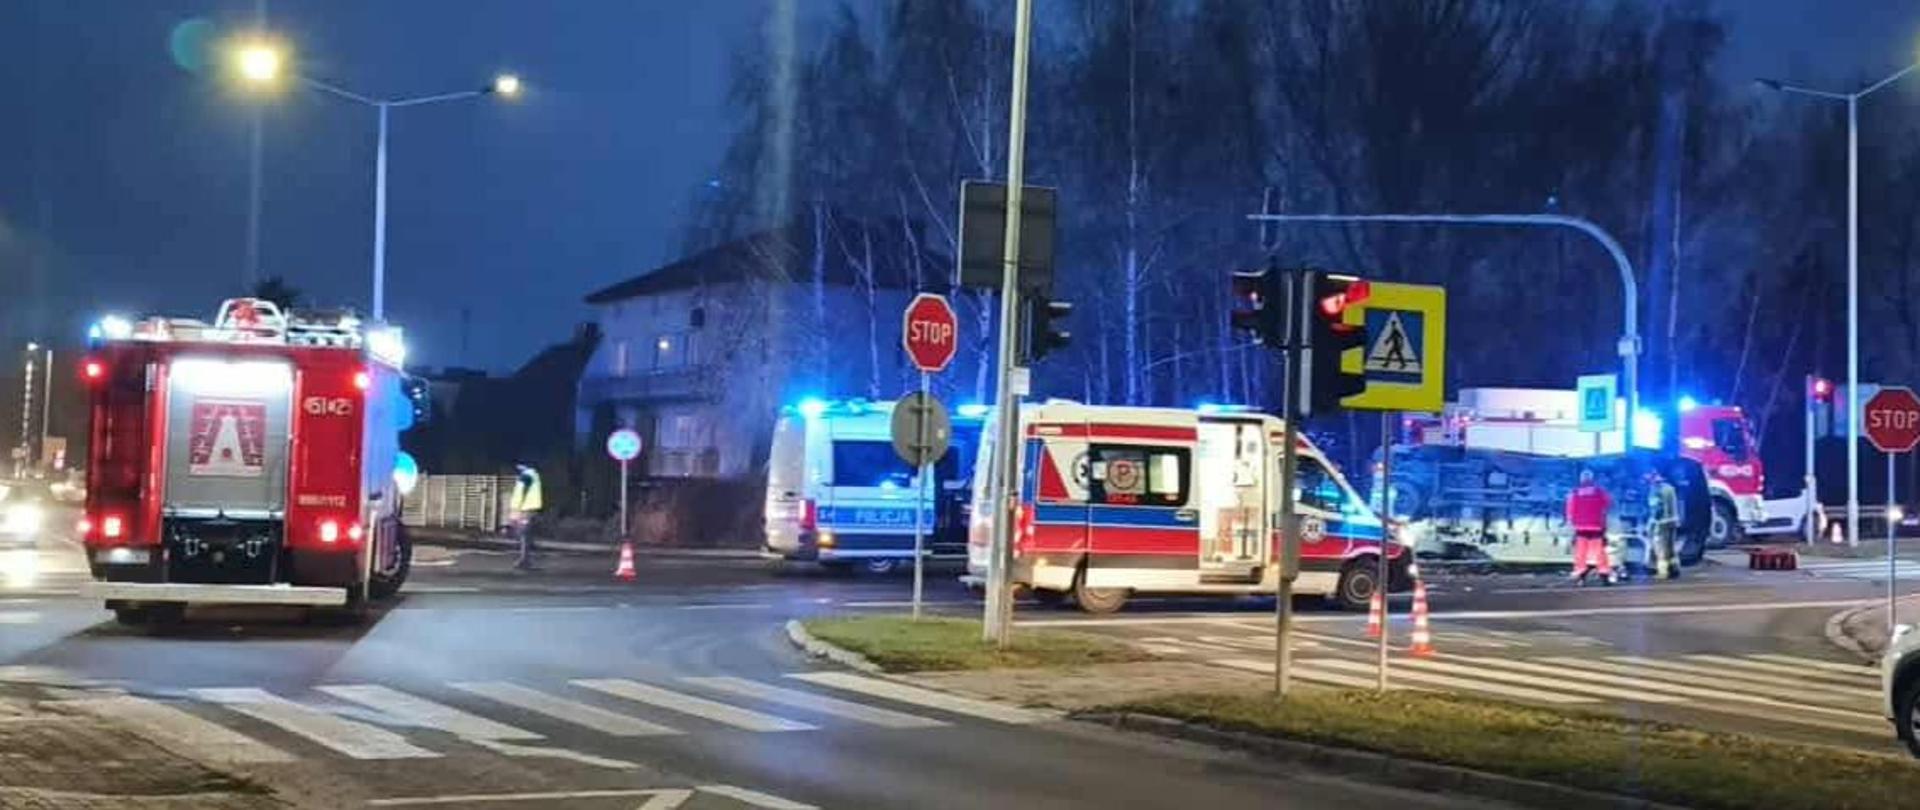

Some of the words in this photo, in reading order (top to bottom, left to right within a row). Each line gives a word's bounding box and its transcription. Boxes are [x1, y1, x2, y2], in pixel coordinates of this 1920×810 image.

[911, 321, 952, 346] STOP
[1870, 409, 1919, 429] STOP
[855, 510, 913, 522] POLICJA
